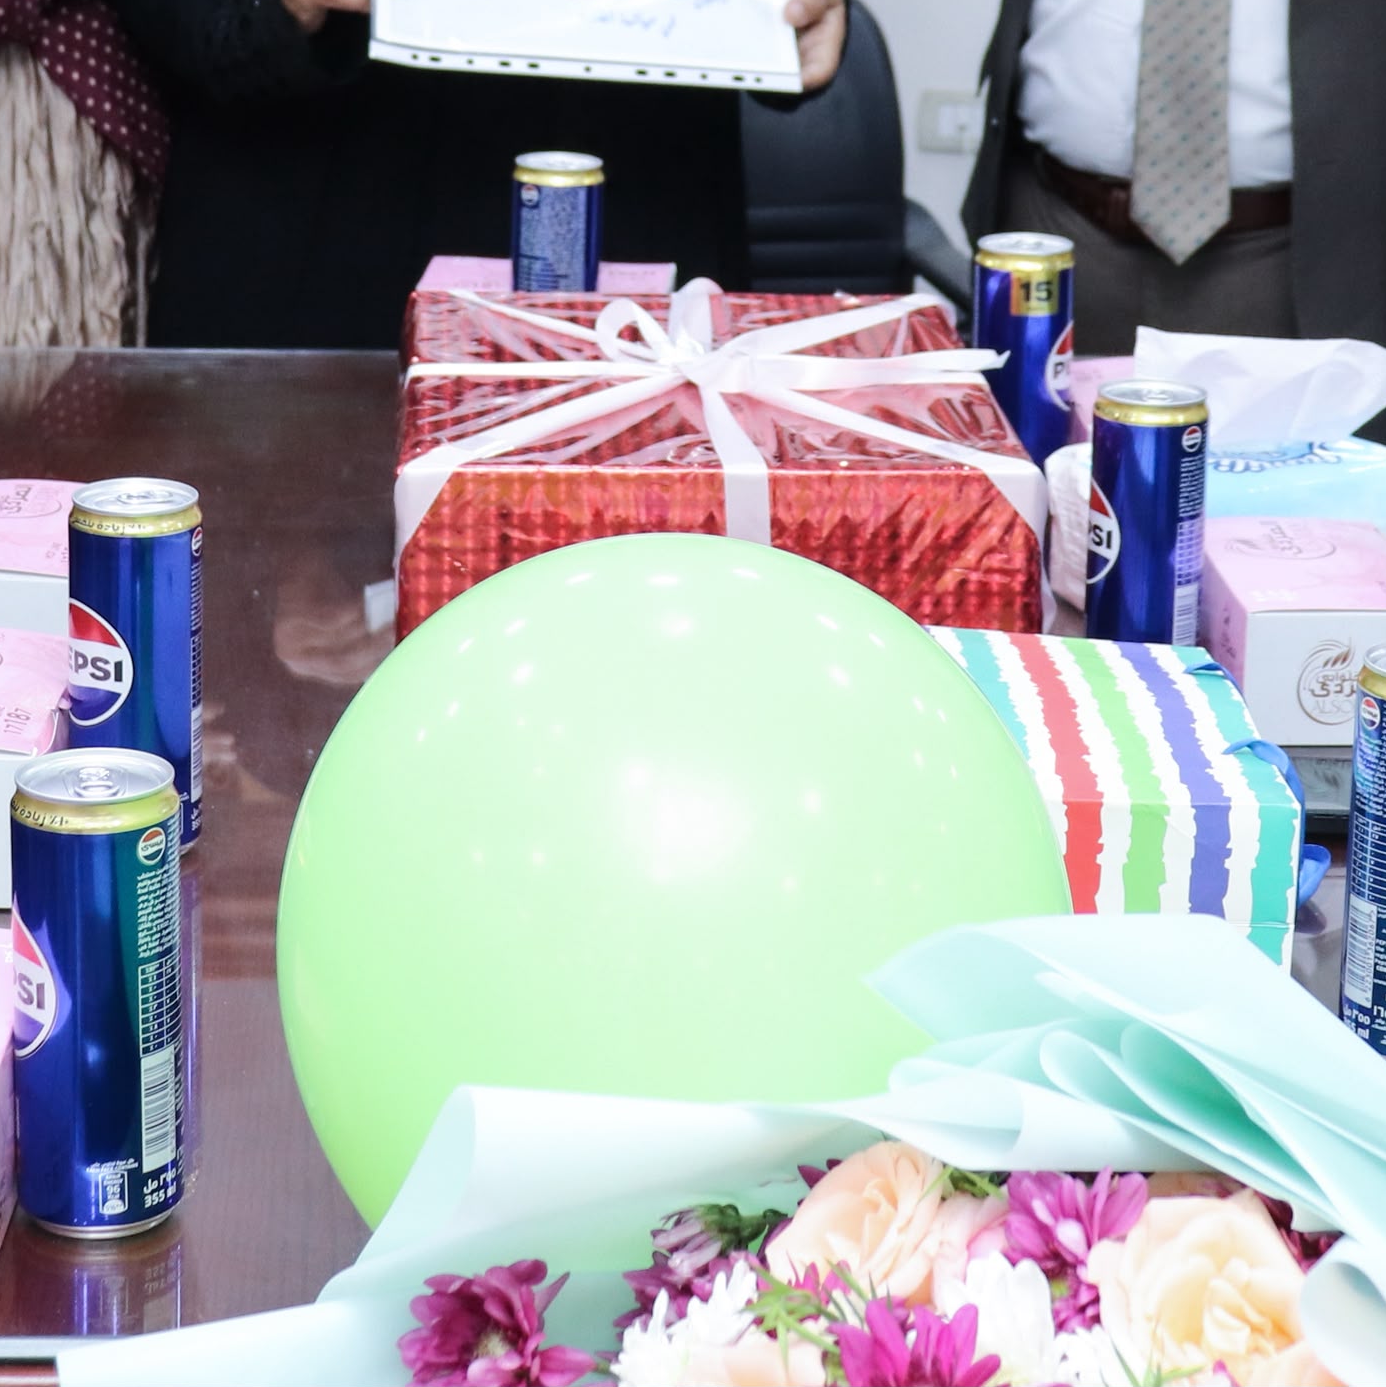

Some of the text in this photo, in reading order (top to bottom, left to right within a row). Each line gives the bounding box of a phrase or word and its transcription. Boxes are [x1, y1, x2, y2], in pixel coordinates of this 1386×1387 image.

[1020, 281, 1053, 303] 15
[70, 647, 123, 683] PSI
[3, 707, 32, 736] 17187
[143, 1188, 166, 1209] 355
